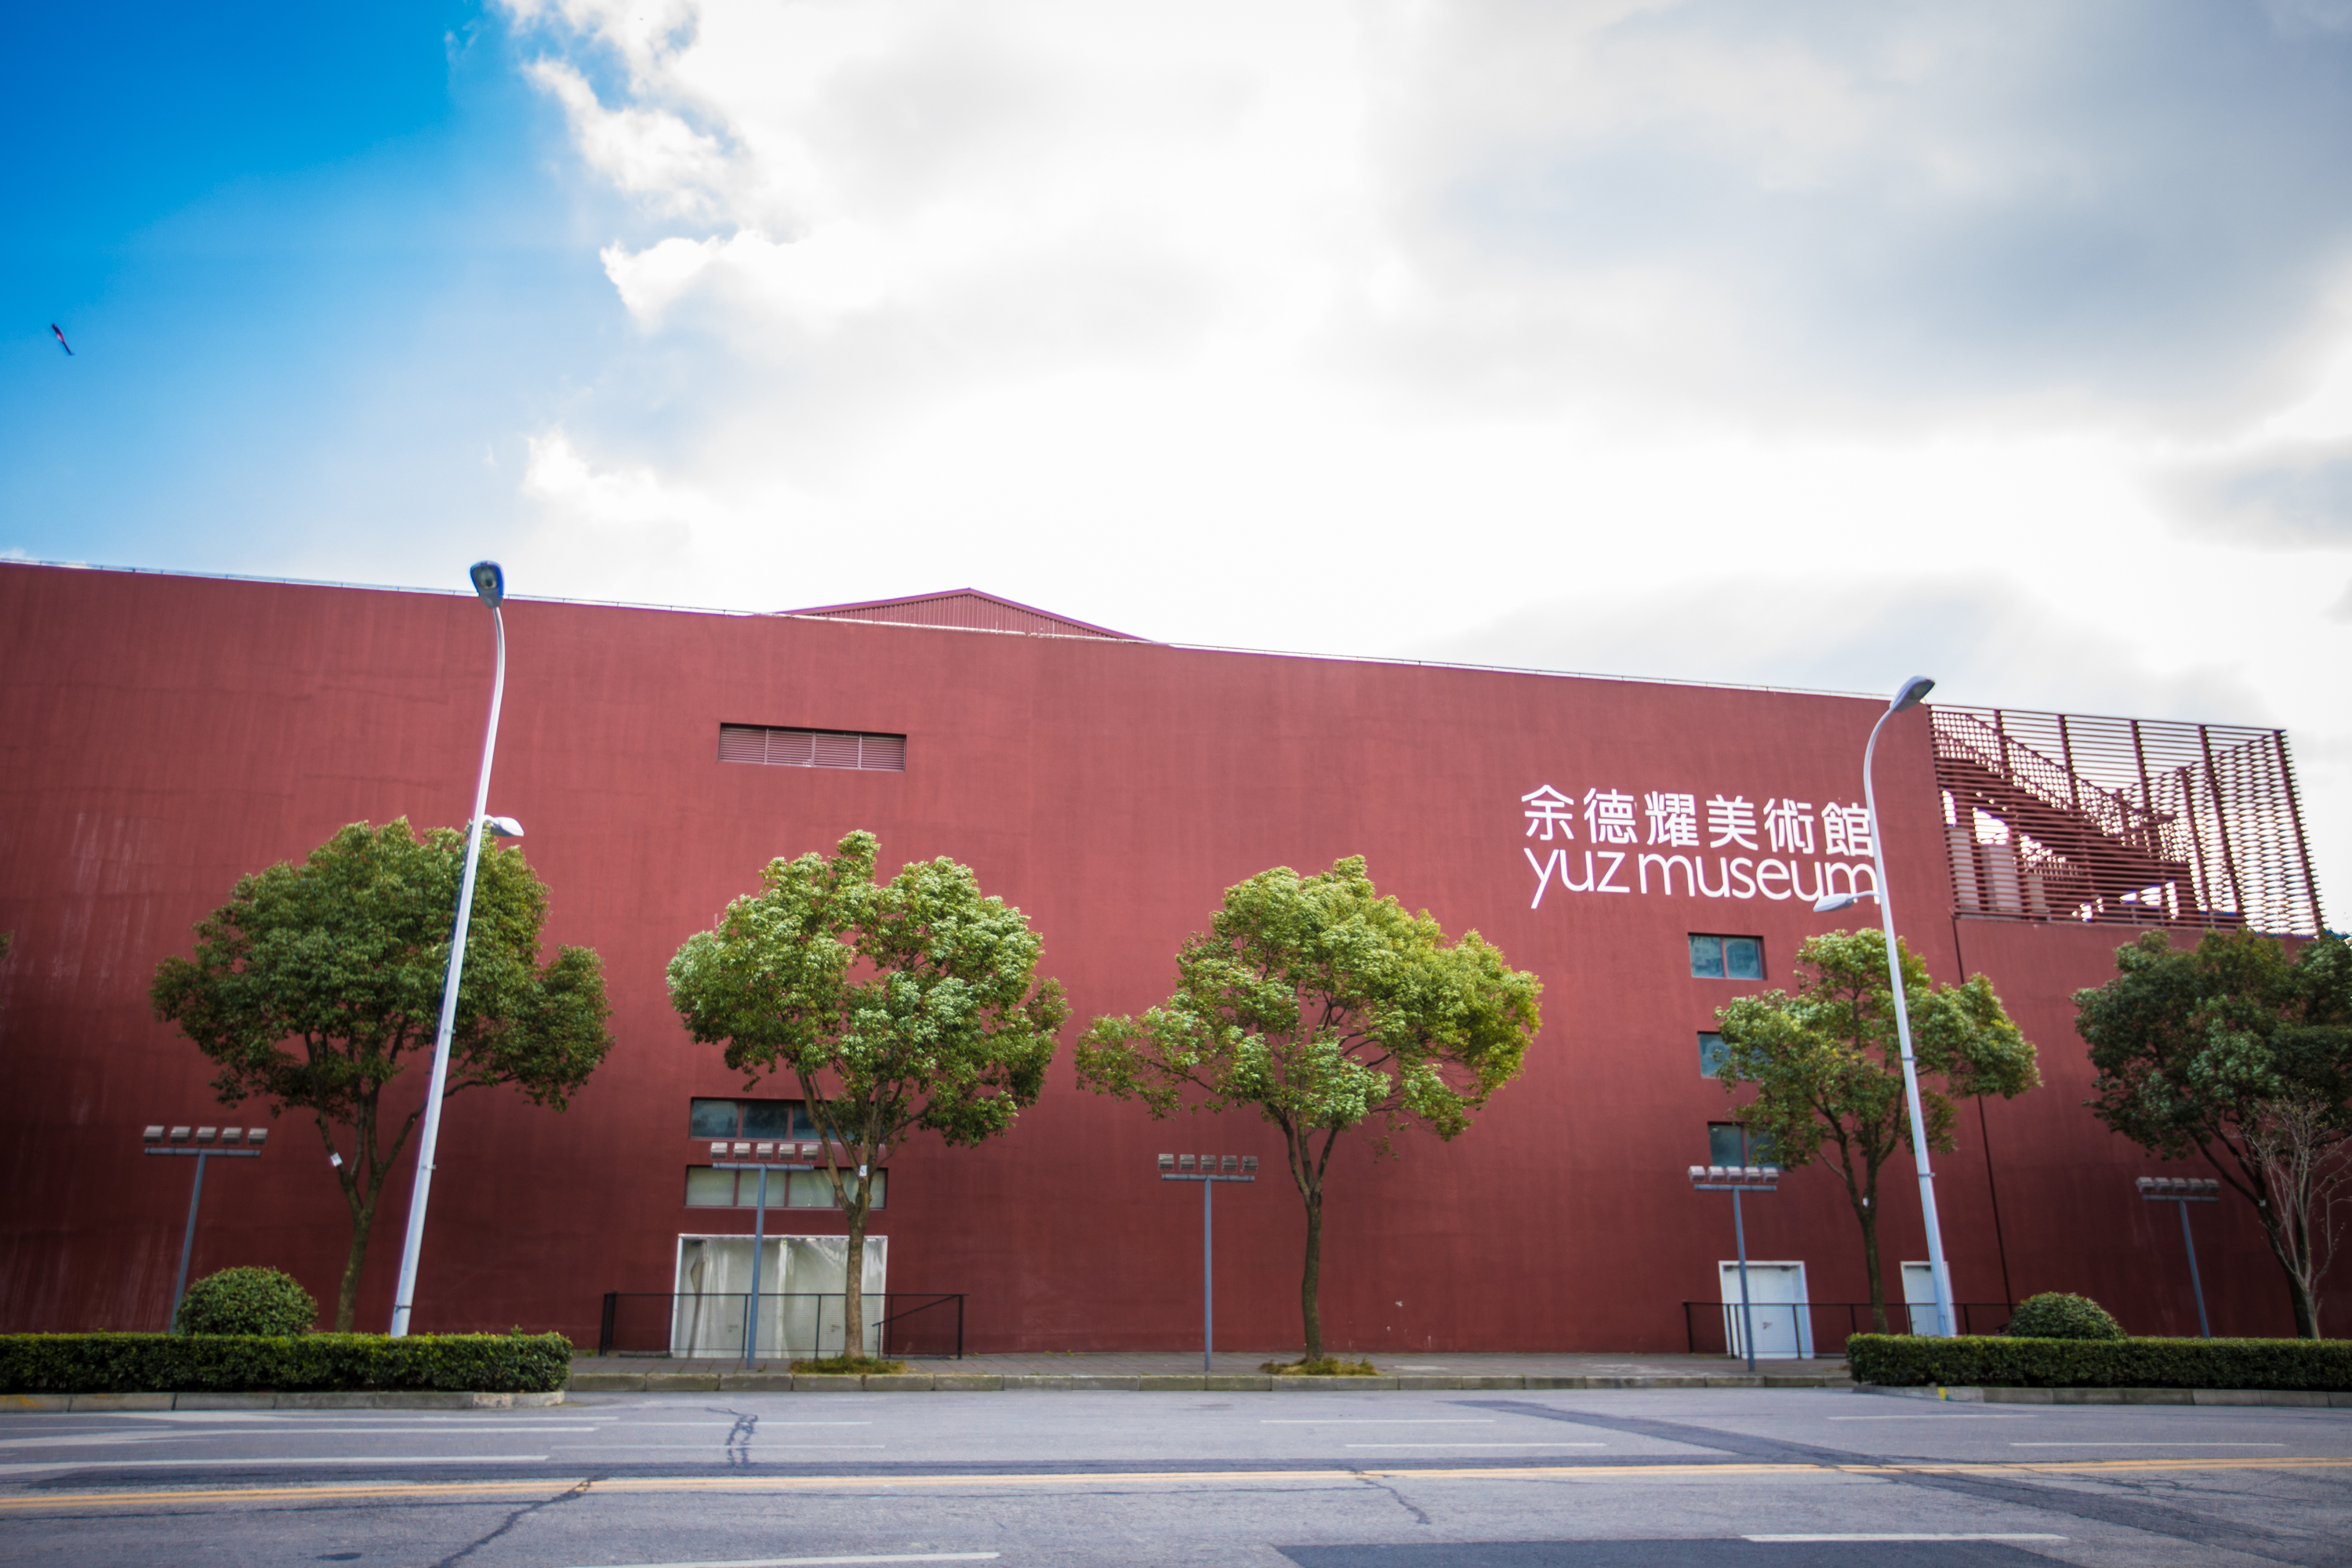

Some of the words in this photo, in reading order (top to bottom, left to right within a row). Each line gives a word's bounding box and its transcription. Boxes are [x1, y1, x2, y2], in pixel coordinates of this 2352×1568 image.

[1521, 784, 1875, 858] 余德耀美術館
[1523, 848, 1630, 909] yuz
[1639, 852, 1881, 905] museum
